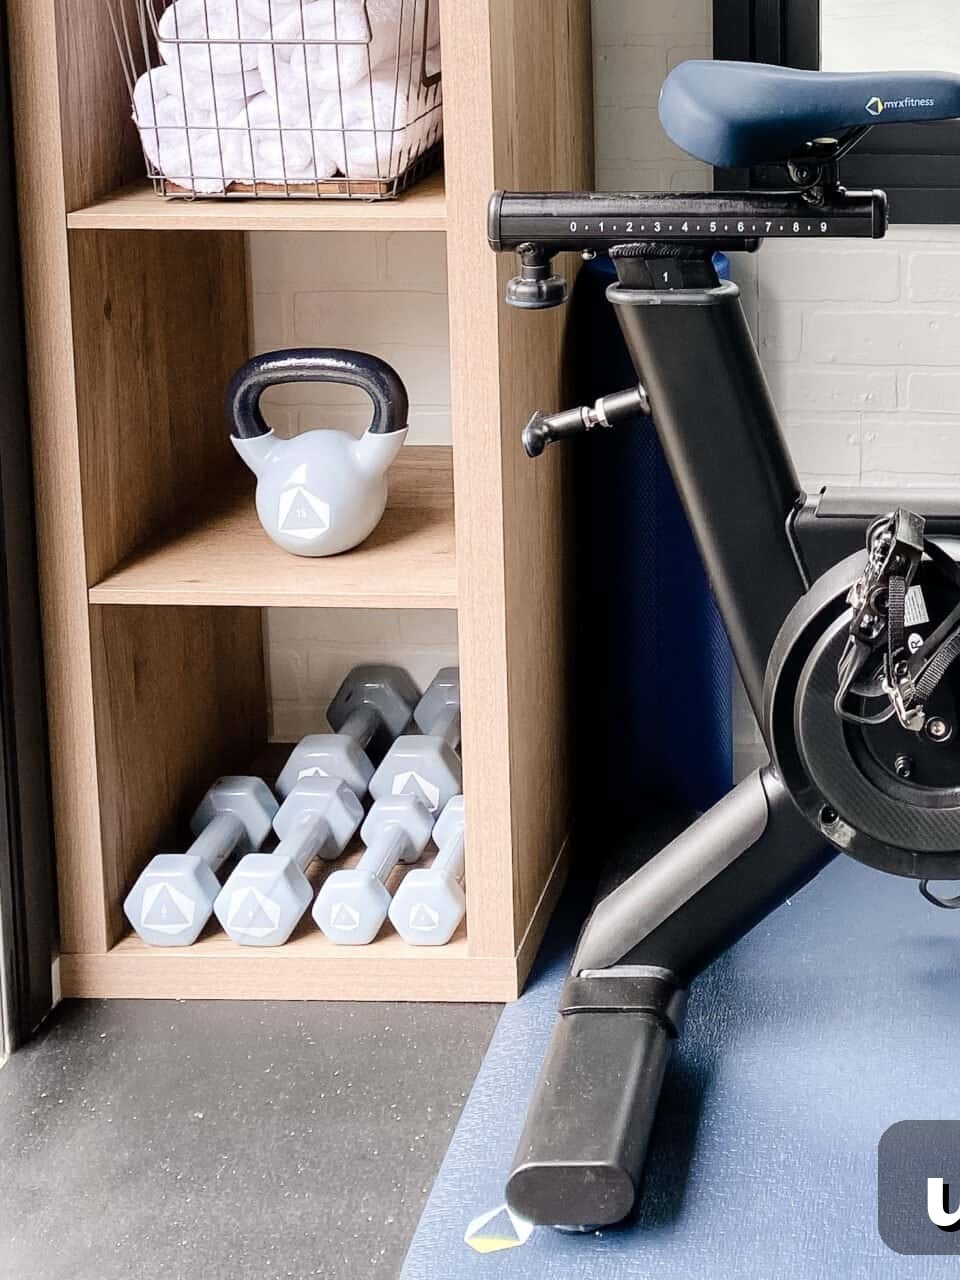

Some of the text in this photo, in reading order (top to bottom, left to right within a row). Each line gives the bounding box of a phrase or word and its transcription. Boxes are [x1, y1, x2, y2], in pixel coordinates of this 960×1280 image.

[884, 97, 935, 109] myxfitness
[569, 221, 829, 233] 0 1 2 3 4 5 6 7 8 9
[662, 271, 669, 283] 1
